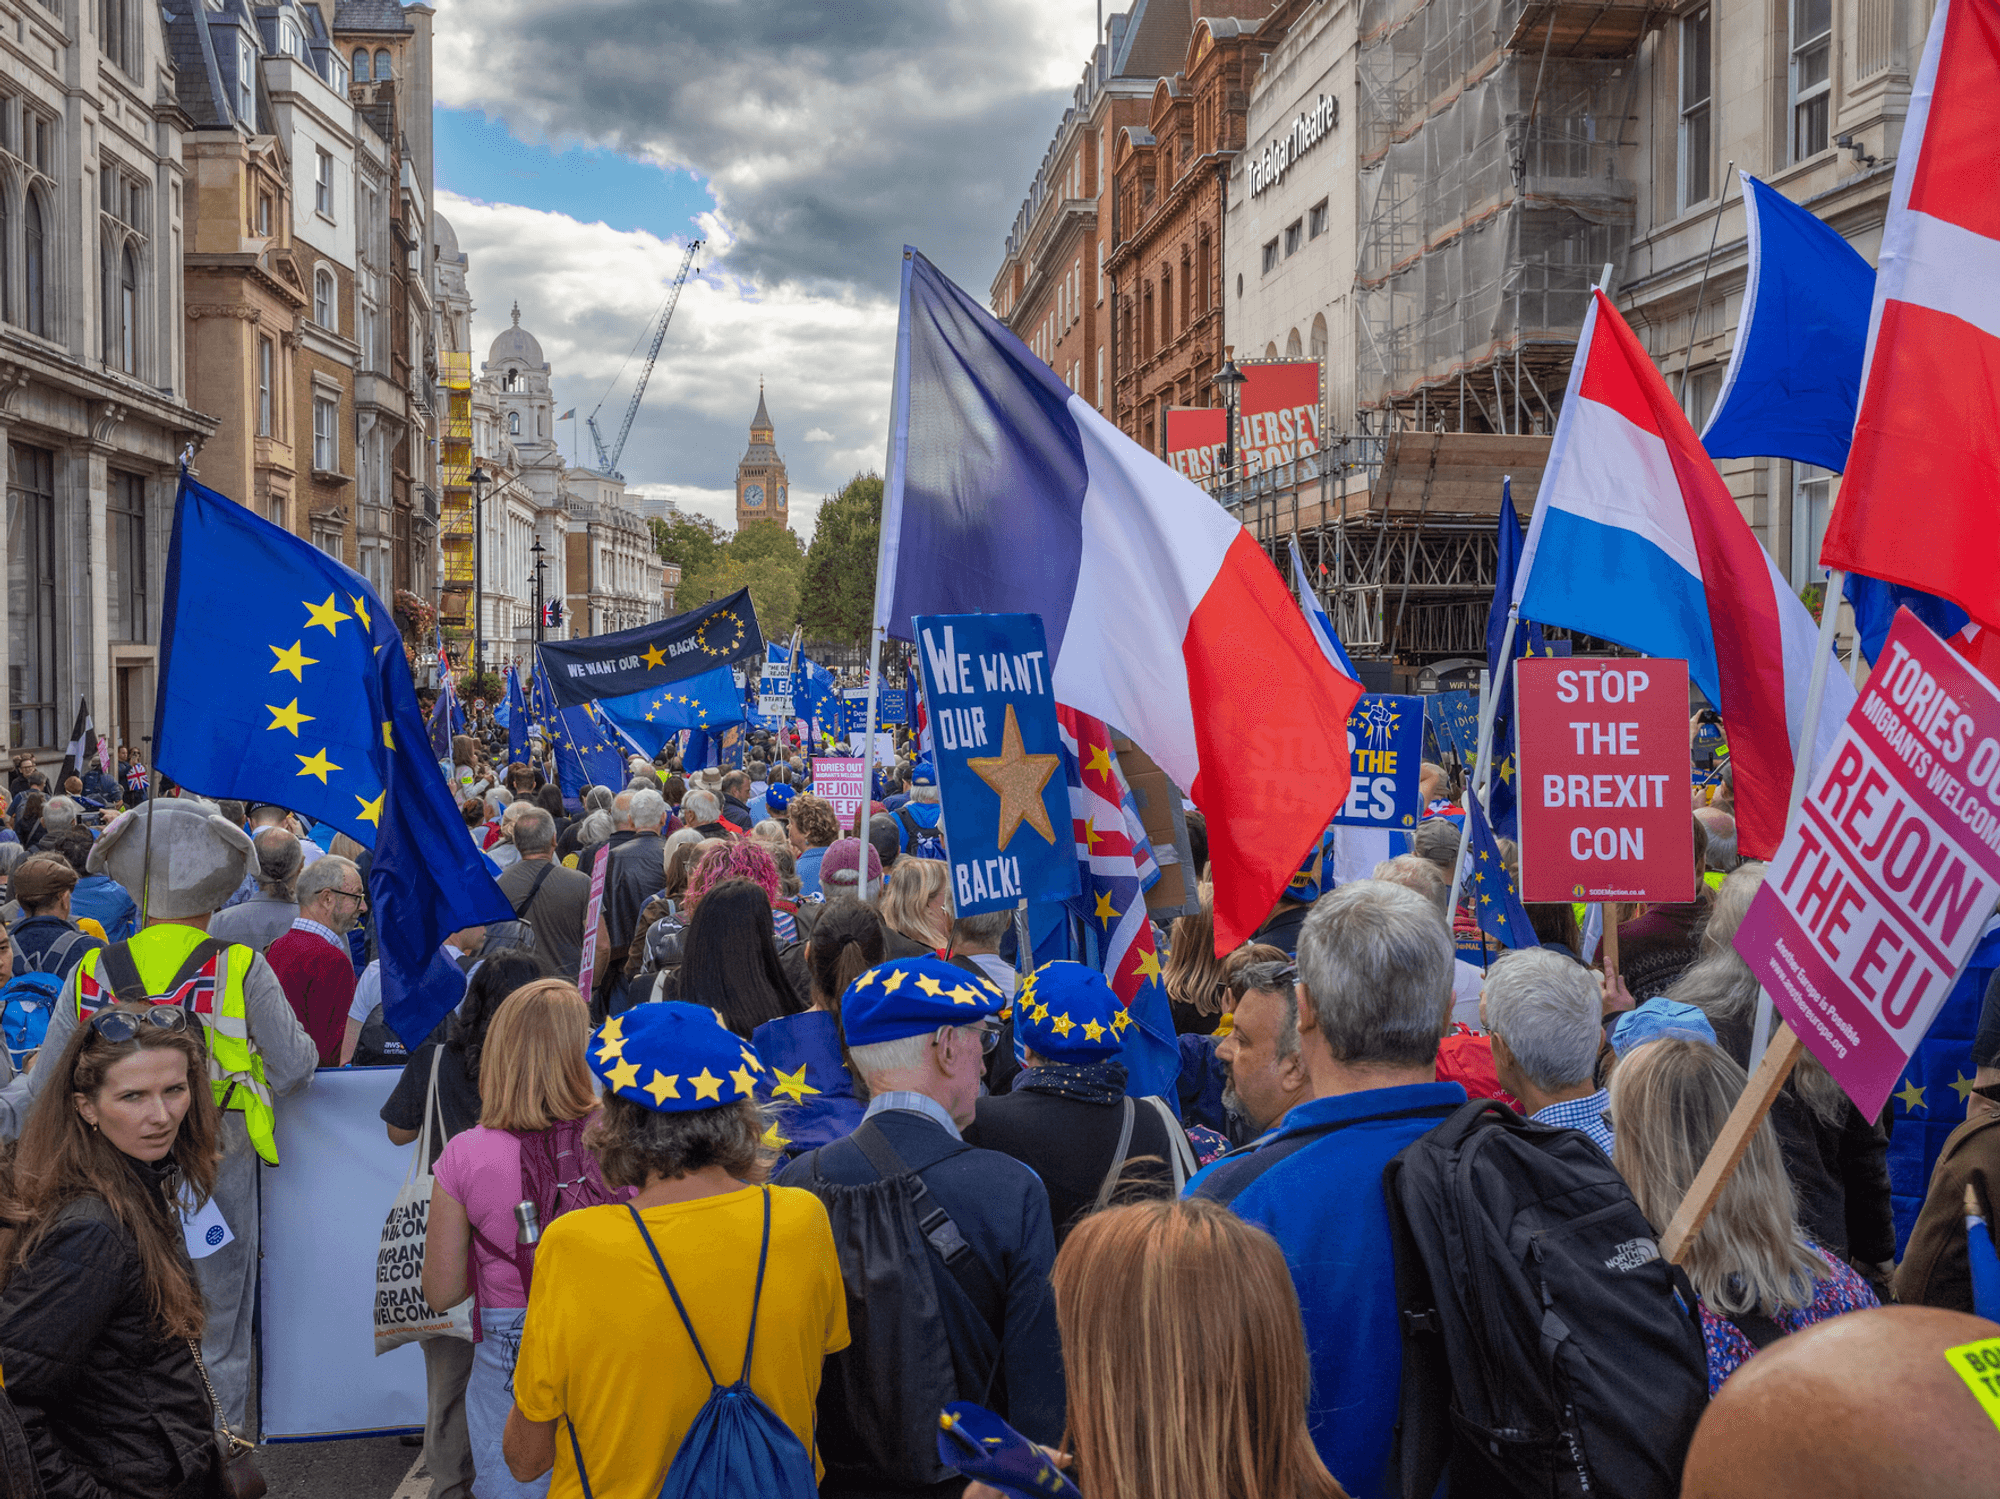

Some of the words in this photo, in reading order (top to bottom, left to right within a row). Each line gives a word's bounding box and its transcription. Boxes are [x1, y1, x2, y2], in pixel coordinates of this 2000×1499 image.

[1247, 134, 1291, 198] Trafalgar
[1292, 94, 1337, 160] Theatre
[1240, 404, 1319, 450] JERSEY
[567, 663, 586, 679] WE
[585, 659, 617, 676] WANT
[618, 654, 640, 671] OUR
[668, 636, 699, 658] BACK
[979, 651, 1045, 695] WANT
[1556, 670, 1649, 703] STOP
[938, 707, 988, 750] OUR
[1568, 722, 1640, 755] THE
[1881, 640, 1976, 763] TORIES
[1967, 737, 2000, 807] OU
[815, 763, 845, 772] TORIES
[846, 763, 863, 772] OUT
[1355, 749, 1397, 774] THE
[1861, 689, 1932, 778] MIGRANTS
[1926, 761, 2000, 857] WELCOM
[816, 782, 863, 796] REJOIN
[1543, 774, 1670, 808] BREXIT
[1570, 827, 1645, 860] CON
[1818, 738, 1985, 948] REJOIN
[955, 855, 1022, 907] BACK!
[1780, 823, 1867, 962] THE
[1850, 918, 1933, 1030] EU
[1768, 956, 1848, 1059] www.anothereurope.org
[1798, 967, 1822, 1003] Europe
[1818, 996, 1828, 1011] is
[1826, 1004, 1861, 1046] Possible
[1604, 1248, 1639, 1269] NORTH
[1614, 1240, 1637, 1254] THE
[1619, 1256, 1643, 1273] FACE
